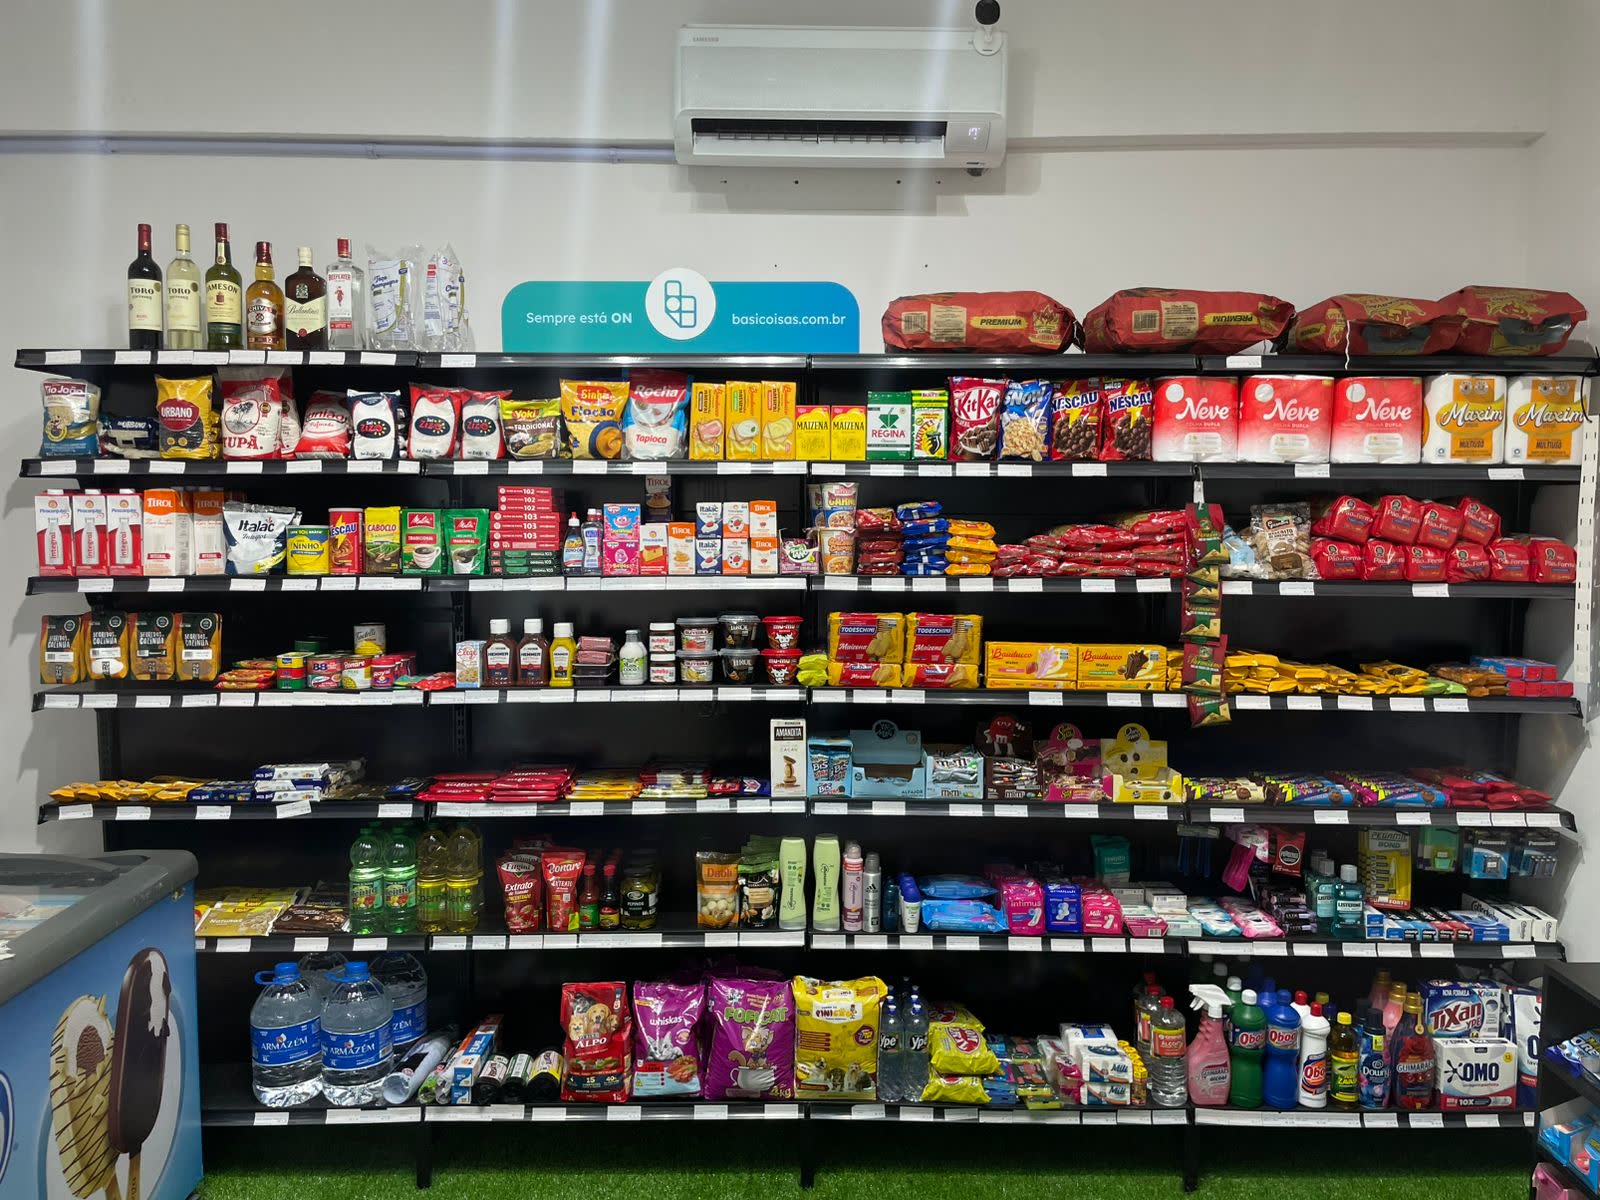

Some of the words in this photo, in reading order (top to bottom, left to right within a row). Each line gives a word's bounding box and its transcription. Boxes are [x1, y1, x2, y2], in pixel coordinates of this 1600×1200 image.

[131, 287, 154, 295] TORO
[168, 287, 191, 295] TORO
[526, 312, 576, 330] Sempre
[580, 312, 607, 325] está
[611, 312, 633, 325] ON
[732, 311, 847, 329] basicoisas.com.br
[45, 385, 57, 394] Tio
[58, 384, 83, 395] João
[635, 385, 679, 398] Rocha
[1005, 389, 1046, 406] SNOW
[1052, 391, 1099, 411] NESCAU
[161, 406, 193, 418] URBANO
[515, 410, 537, 420] Yoki
[1175, 398, 1230, 421] Neve
[1262, 398, 1320, 422] Neve
[1355, 398, 1413, 421] Neve
[1440, 403, 1504, 427] Maxim
[1516, 403, 1584, 427] Maxim
[514, 421, 554, 431] TRADICIONAL
[797, 422, 829, 431] MAIZENA
[833, 422, 865, 431] MAIZENA
[636, 434, 668, 444] Tapioca
[871, 430, 906, 439] REGINA
[648, 478, 670, 487] TIROL
[147, 498, 173, 509] TIROL
[196, 499, 221, 510] TIROL
[700, 504, 719, 514] Italac
[754, 504, 772, 512] TIROL
[237, 519, 275, 533] Italac
[330, 523, 358, 538] ESCAU
[368, 523, 397, 532] CABOCLO
[523, 522, 537, 530] 103
[671, 527, 691, 536] TIROL
[293, 543, 320, 551] NINHO
[698, 541, 718, 551] Italac
[755, 540, 773, 549] TIROL
[841, 626, 877, 634] TODESCHINI
[918, 626, 953, 634] TODESCHINI
[991, 648, 1033, 661] Bauducco
[1081, 649, 1123, 663] Bauducco
[812, 762, 829, 771] Bis
[833, 763, 849, 773] Bis
[818, 784, 833, 794] Bis
[547, 861, 582, 874] Bonare
[504, 881, 534, 892] Extrato
[1011, 900, 1042, 908] intimus
[649, 1015, 683, 1026] whiskas
[261, 1036, 309, 1051] ARMAZÉM
[575, 1037, 608, 1050] ALPO
[1570, 1035, 1600, 1058] ORE
[329, 1043, 376, 1056] ARMAZÉM
[1463, 1062, 1500, 1083] OMO
[586, 1076, 596, 1084] 15
